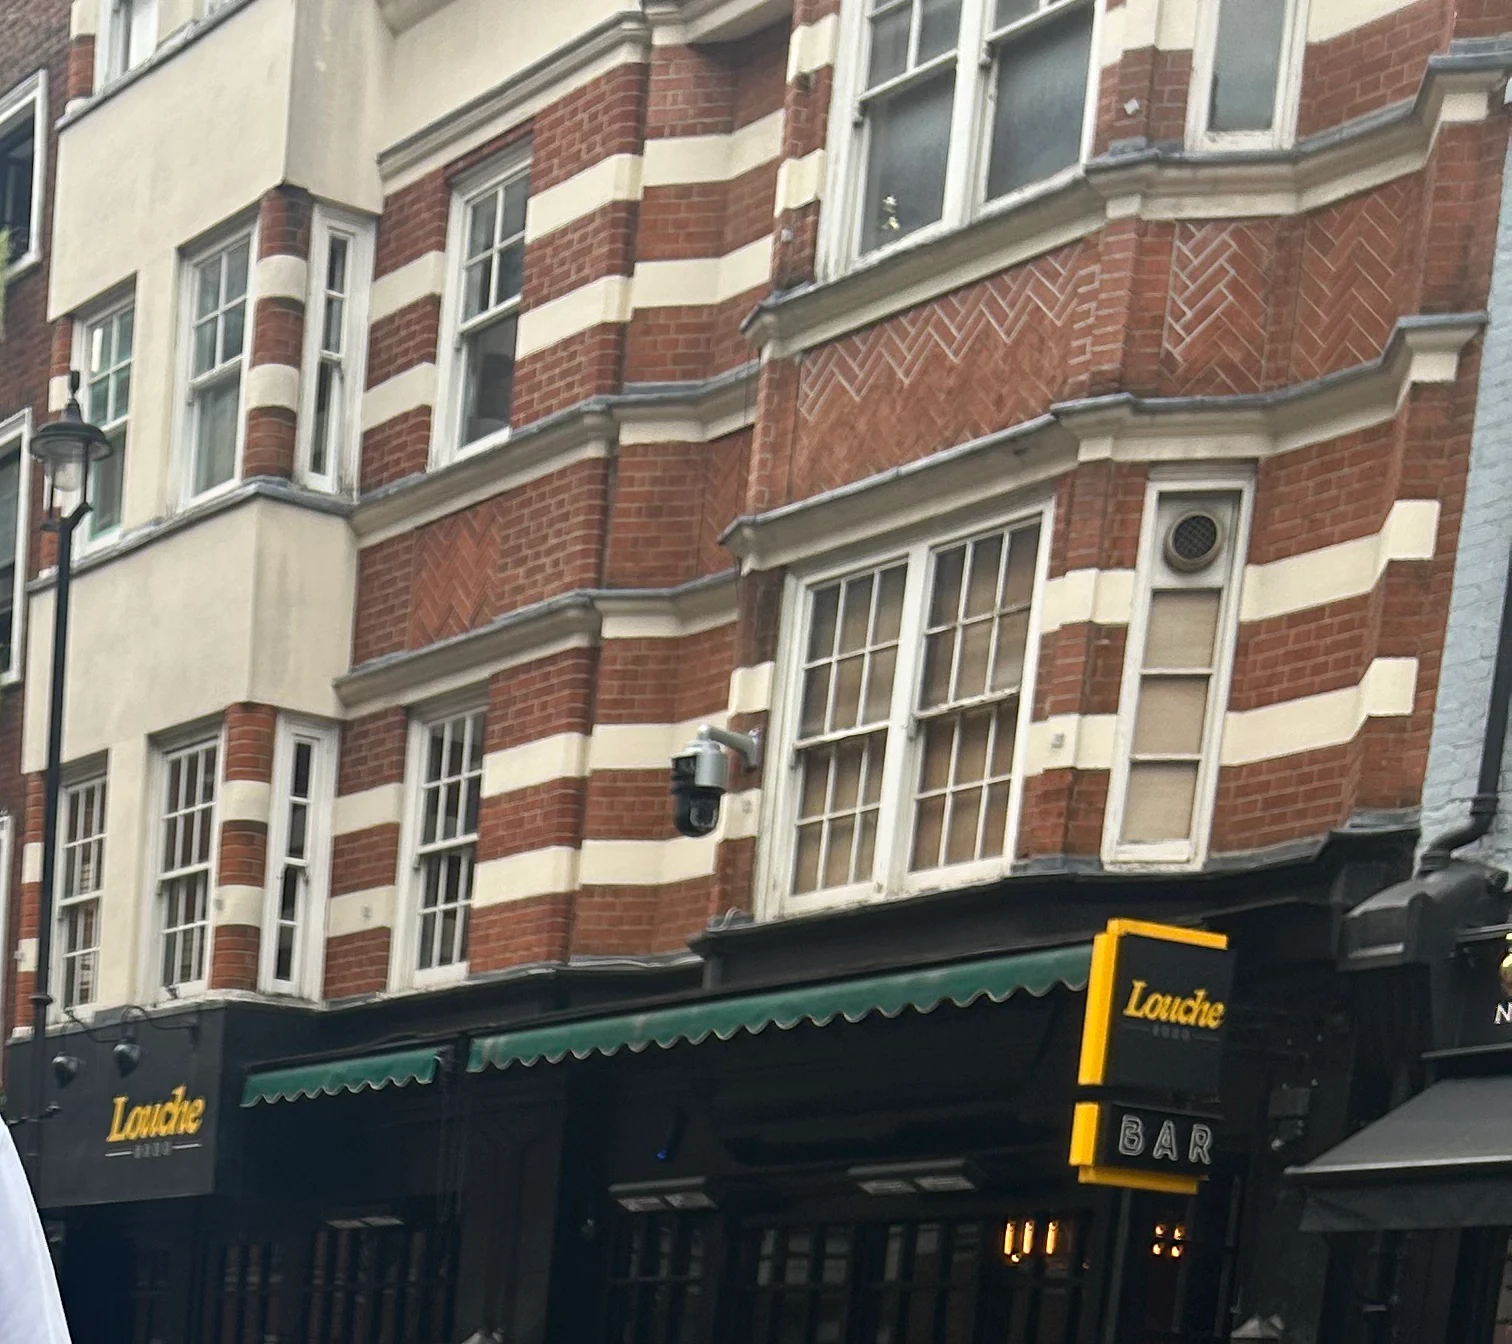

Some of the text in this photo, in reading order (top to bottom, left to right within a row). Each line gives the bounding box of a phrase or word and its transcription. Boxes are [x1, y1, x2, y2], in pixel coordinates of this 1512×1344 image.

[1122, 979, 1225, 1031] Louche
[106, 1083, 206, 1143] Louche
[1118, 1114, 1213, 1166] BAR
